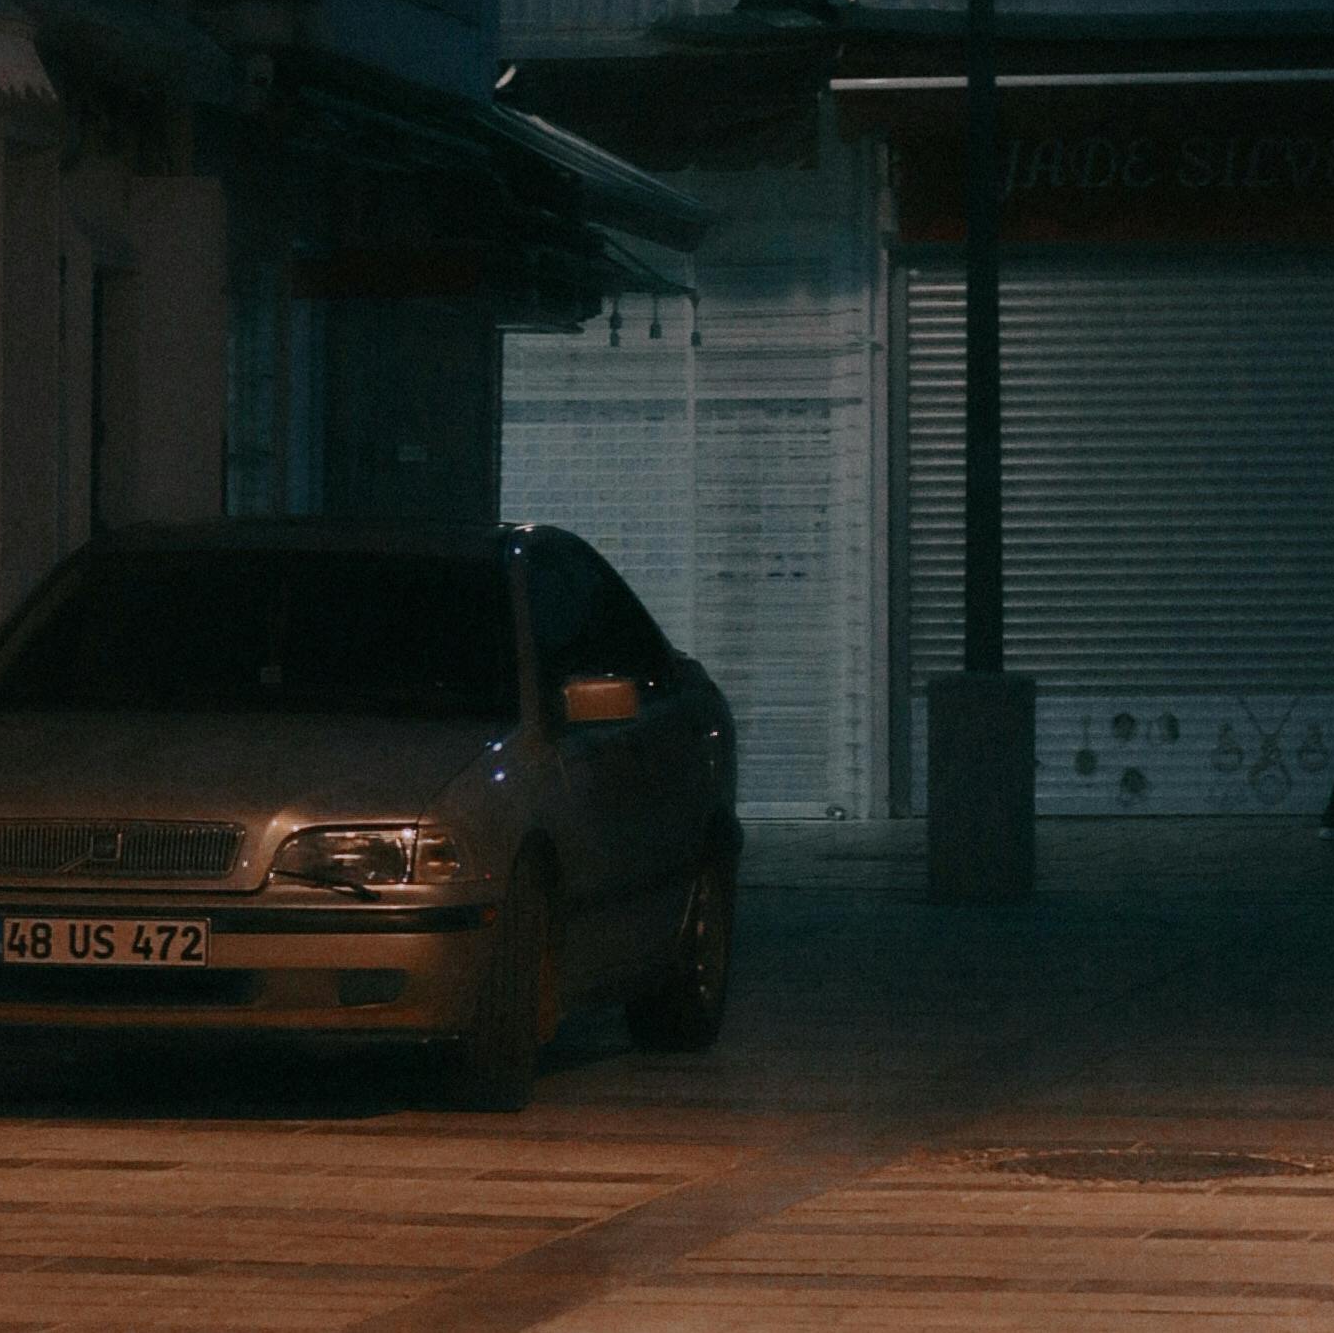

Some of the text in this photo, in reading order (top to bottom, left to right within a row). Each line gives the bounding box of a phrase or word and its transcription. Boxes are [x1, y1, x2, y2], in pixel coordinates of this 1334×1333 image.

[997, 137, 1158, 202] JADE
[7, 922, 203, 962] 48 US 472
